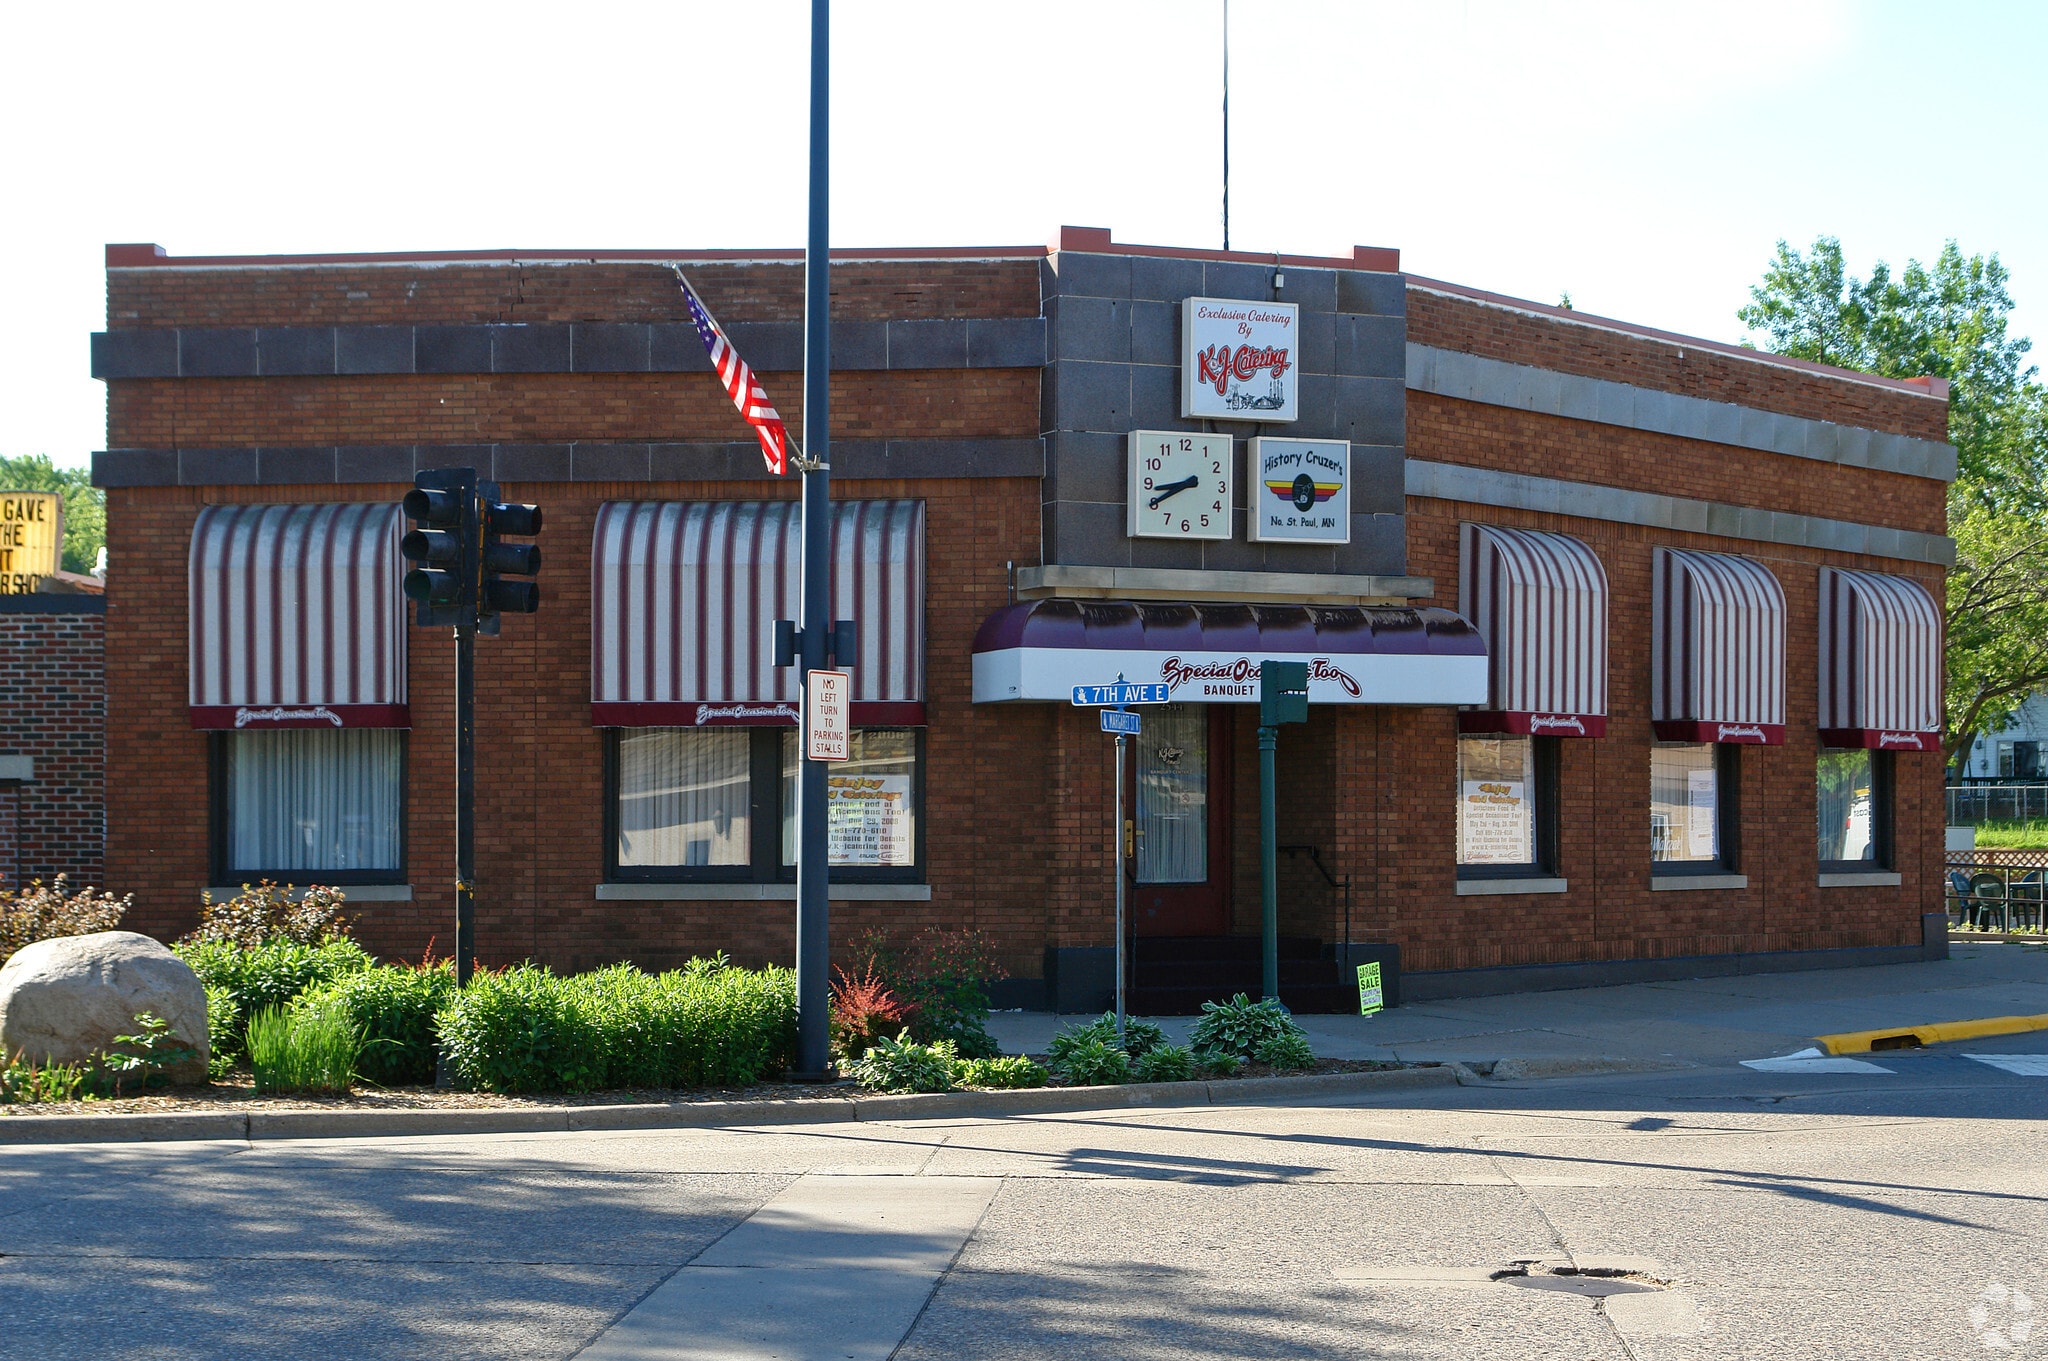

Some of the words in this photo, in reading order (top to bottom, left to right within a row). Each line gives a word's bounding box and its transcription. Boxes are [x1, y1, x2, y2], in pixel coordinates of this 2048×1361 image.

[1198, 306, 1247, 321] Exclusive
[1247, 309, 1291, 328] Catering
[1237, 322, 1252, 339] By
[1231, 344, 1292, 382] Catering
[1160, 443, 1171, 456] 11
[1179, 439, 1192, 452] 12
[1202, 446, 1208, 458] 1
[1146, 458, 1161, 471] 10
[1212, 461, 1221, 474] 2
[1264, 453, 1302, 474] History
[1306, 450, 1343, 476] Cruzer's
[1144, 477, 1153, 490] 9
[1218, 481, 1226, 494] 3
[4, 499, 44, 521] GAVE
[1212, 500, 1222, 513] 4
[1163, 513, 1171, 525] 7
[1181, 519, 1190, 532] 6
[1200, 514, 1209, 527] 5
[1270, 516, 1284, 526] No.
[1286, 517, 1298, 527] St.
[1300, 517, 1318, 529] Paul,
[1321, 518, 1335, 528] MN
[1162, 657, 1232, 694] Special
[1309, 658, 1362, 698] Too
[822, 679, 835, 690] NO
[1204, 685, 1255, 696] BANQUET
[820, 692, 837, 703] LEFT
[1092, 687, 1118, 703] 7TH
[1124, 686, 1148, 702] AVE
[1156, 685, 1164, 701] E
[696, 703, 735, 726] Special
[734, 704, 776, 719] Occasions
[820, 704, 838, 716] TURN
[824, 717, 834, 728] TO
[813, 730, 844, 741] PARKING
[815, 743, 842, 754] STALLS
[828, 777, 885, 790] Enjoy
[1360, 976, 1380, 991] SALE
